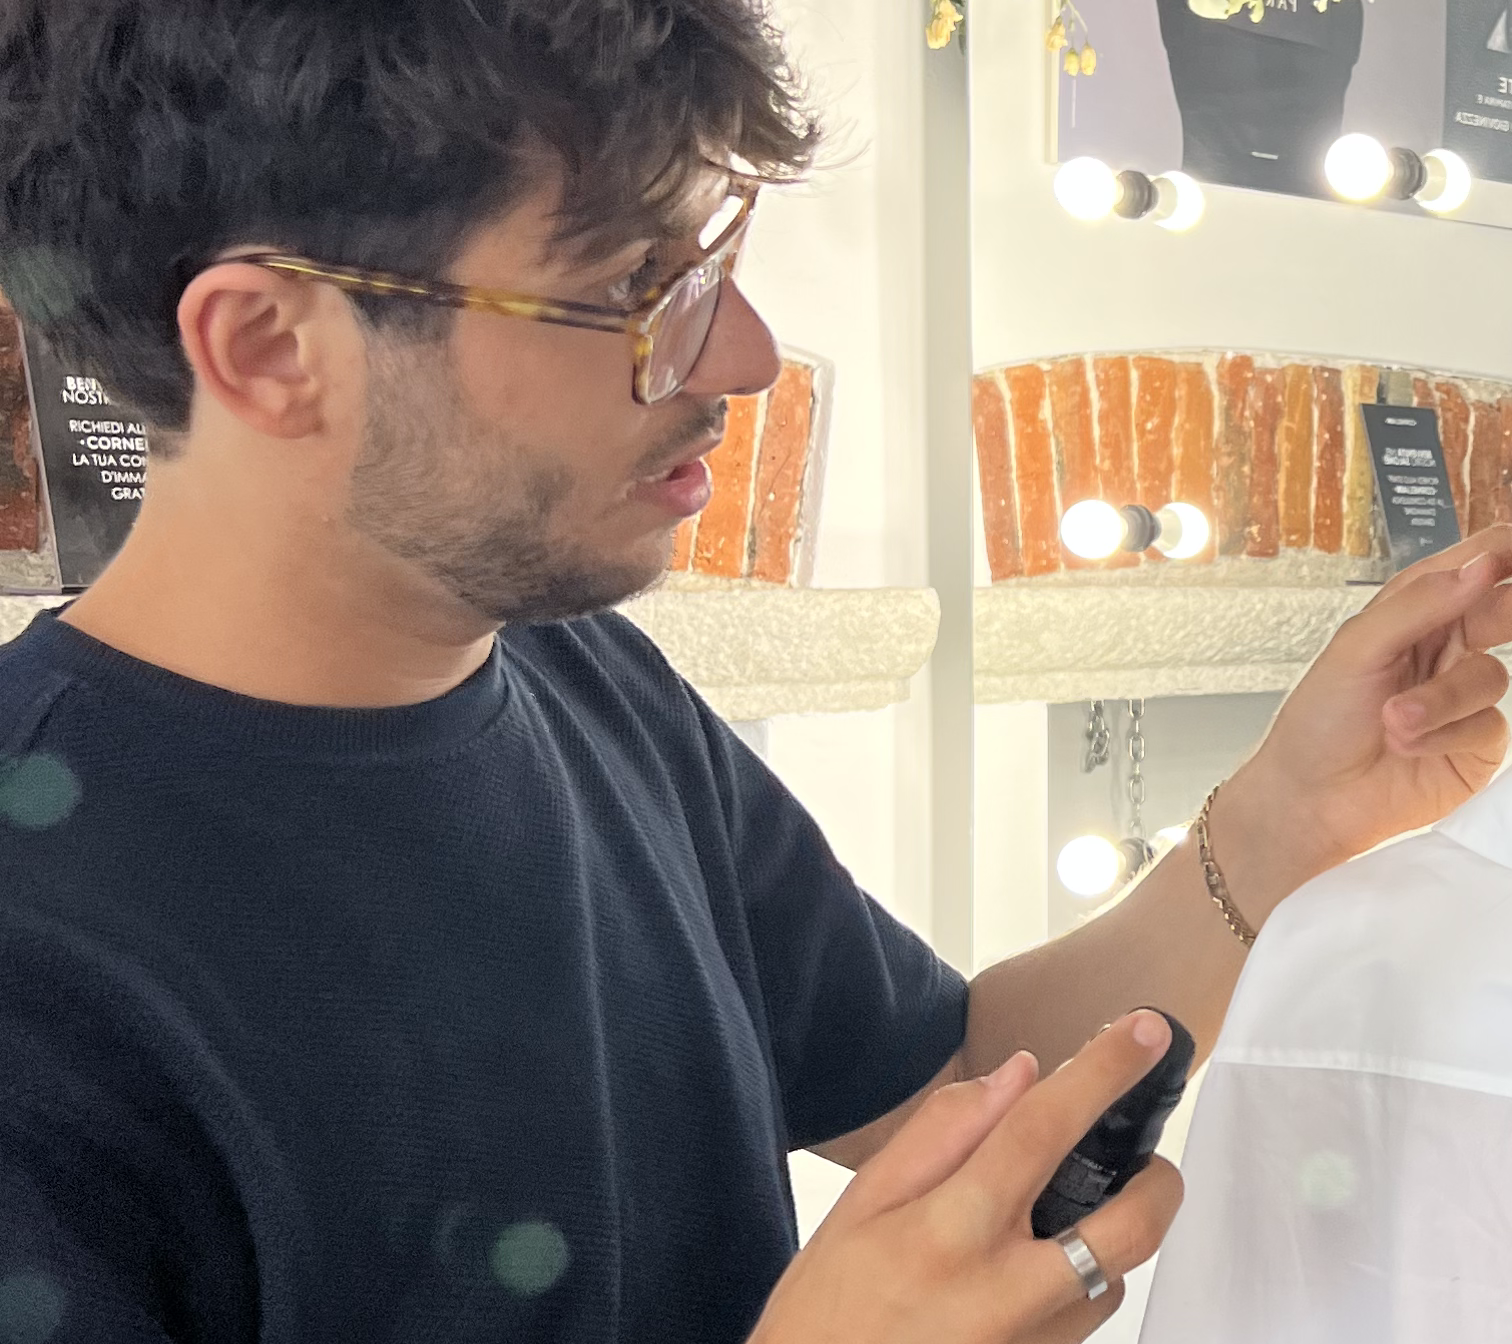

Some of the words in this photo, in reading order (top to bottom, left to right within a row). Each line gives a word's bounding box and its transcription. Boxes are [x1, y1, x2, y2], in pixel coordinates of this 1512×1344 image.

[69, 419, 124, 434] RICHIEDI
[86, 435, 150, 452] CORNE
[72, 453, 89, 466] LA
[91, 454, 117, 467] TUA
